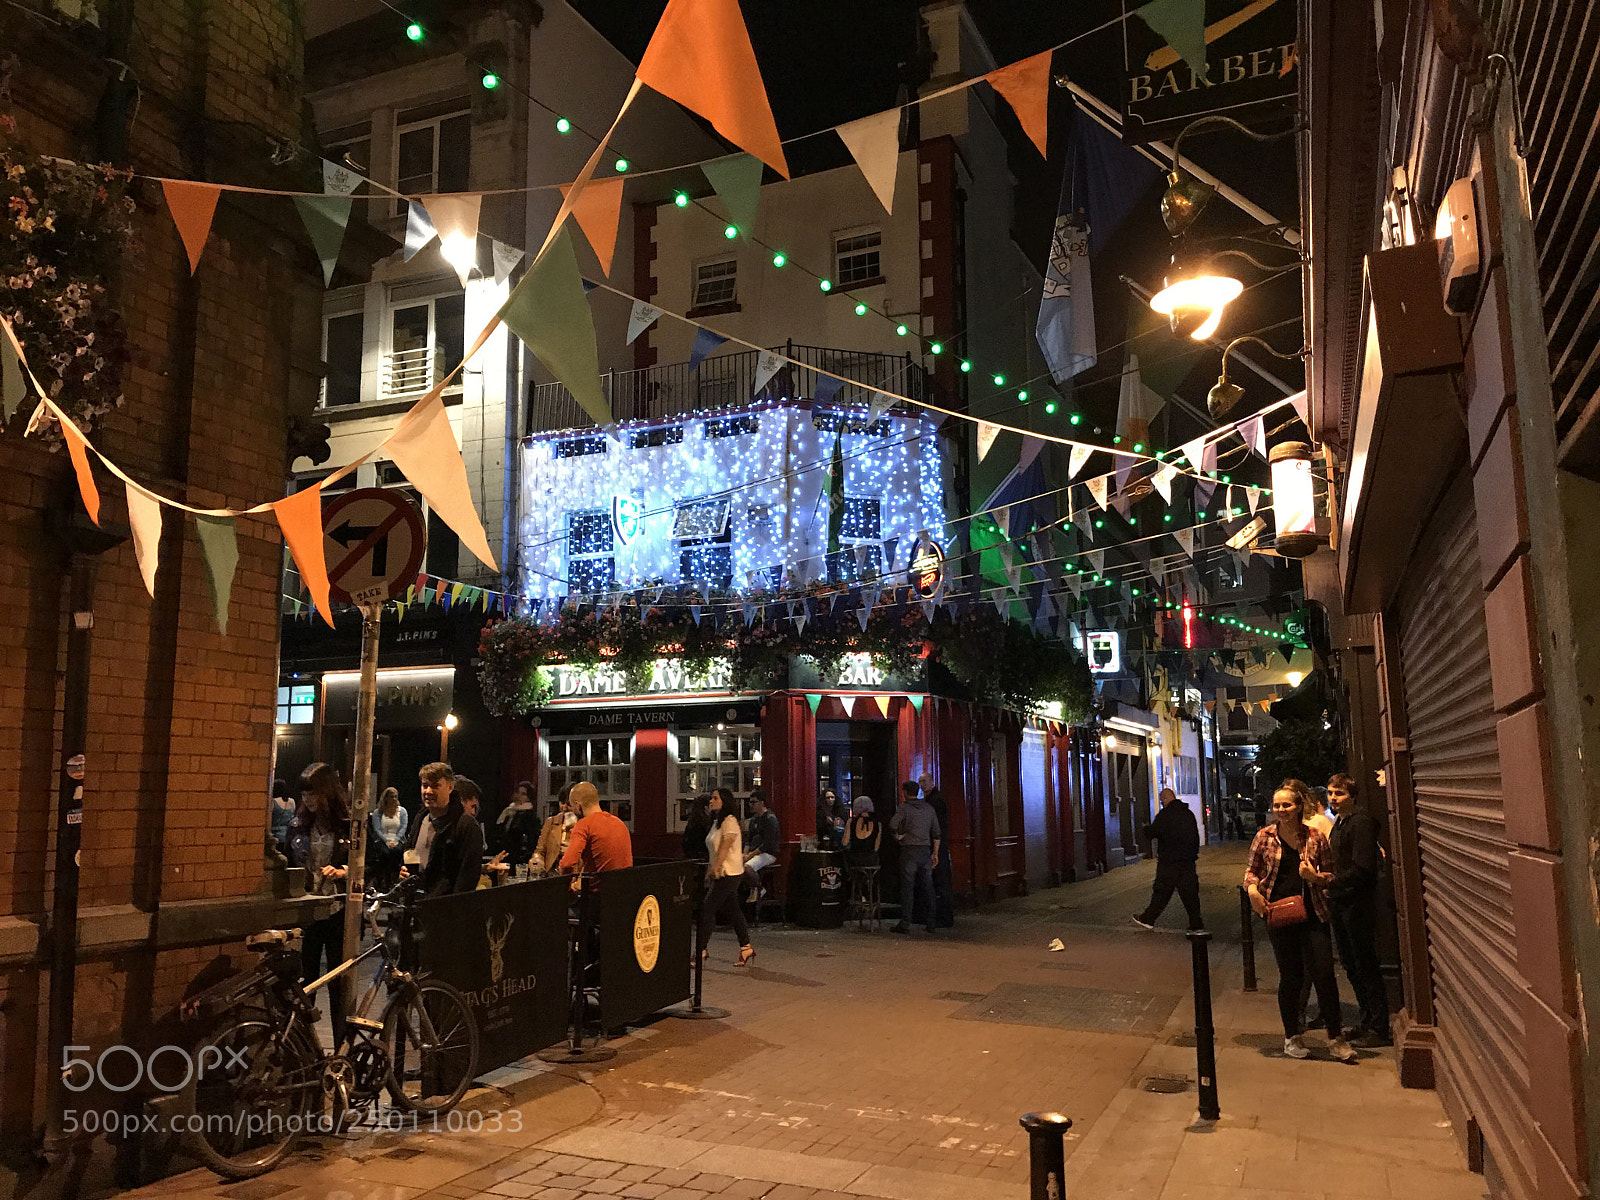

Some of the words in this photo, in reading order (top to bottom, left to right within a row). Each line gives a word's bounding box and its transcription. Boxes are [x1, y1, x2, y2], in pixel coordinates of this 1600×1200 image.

[559, 671, 627, 696] DAME
[838, 666, 882, 685] BAR
[589, 713, 623, 725] DAME
[627, 711, 676, 724] TAVERN
[460, 984, 499, 1007] TAG'S
[502, 974, 537, 998] HEAD
